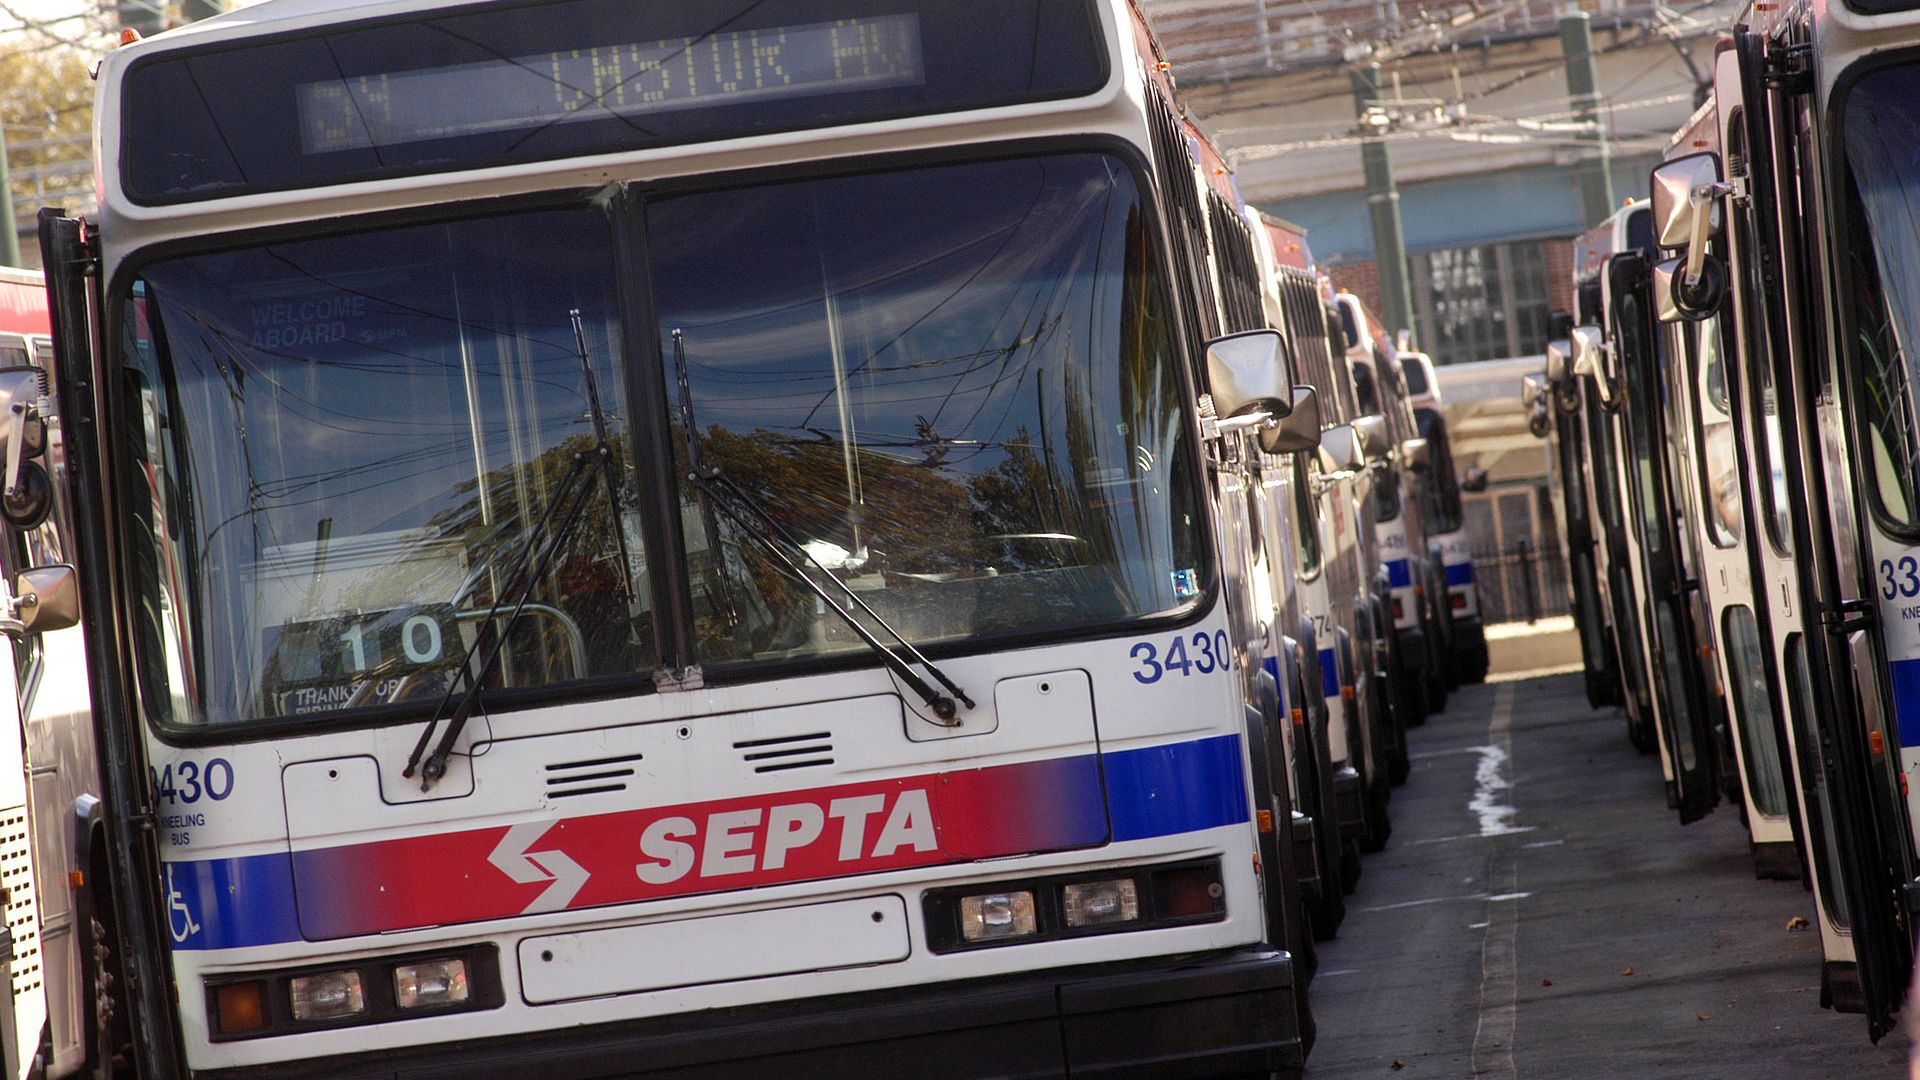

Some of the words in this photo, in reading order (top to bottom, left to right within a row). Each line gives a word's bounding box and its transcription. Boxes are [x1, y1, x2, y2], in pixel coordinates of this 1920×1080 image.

[252, 296, 366, 326] WELCOME
[252, 322, 346, 349] ABOARD
[1130, 629, 1230, 684] 3430
[171, 832, 190, 846] BUS
[635, 788, 938, 885] SEPTA
